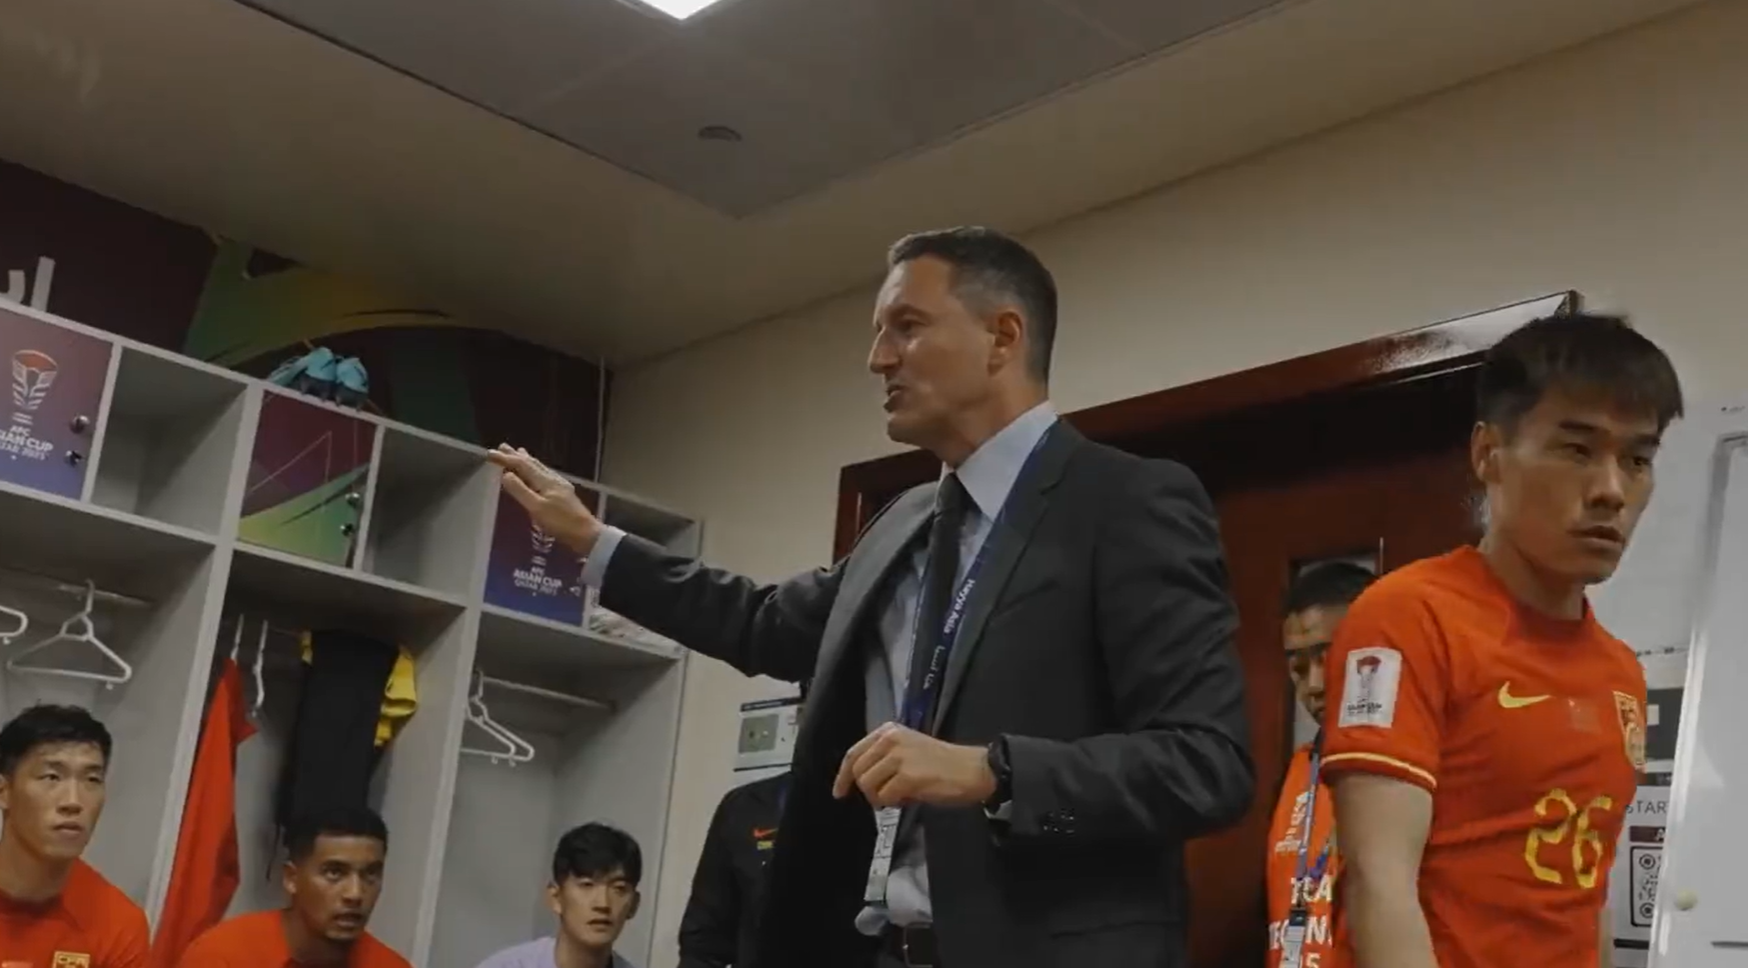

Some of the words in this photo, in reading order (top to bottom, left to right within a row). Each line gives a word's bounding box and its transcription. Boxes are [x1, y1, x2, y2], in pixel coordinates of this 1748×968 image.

[26, 437, 54, 452] CUP
[513, 568, 541, 584] ASIAN
[543, 576, 562, 588] CUP
[1525, 788, 1613, 889] 26
